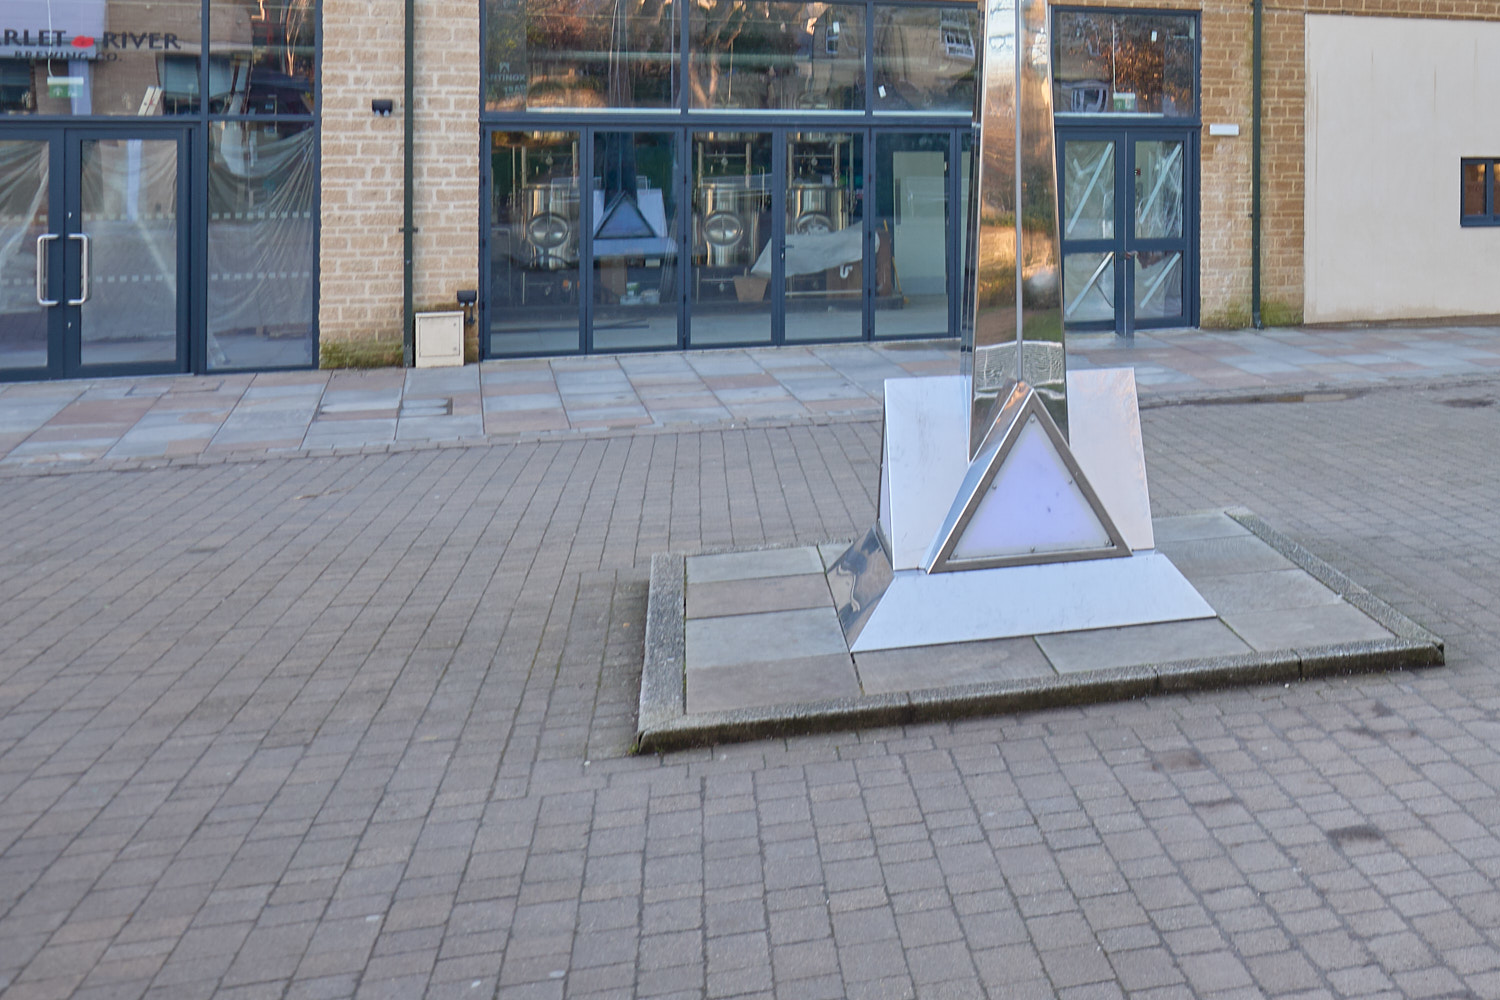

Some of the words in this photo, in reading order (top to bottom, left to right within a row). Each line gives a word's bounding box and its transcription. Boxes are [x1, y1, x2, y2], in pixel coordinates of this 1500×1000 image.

[0, 29, 67, 47] RLET
[103, 31, 181, 50] RIVER
[15, 50, 90, 62] BREWING
[95, 51, 123, 63] CO.
